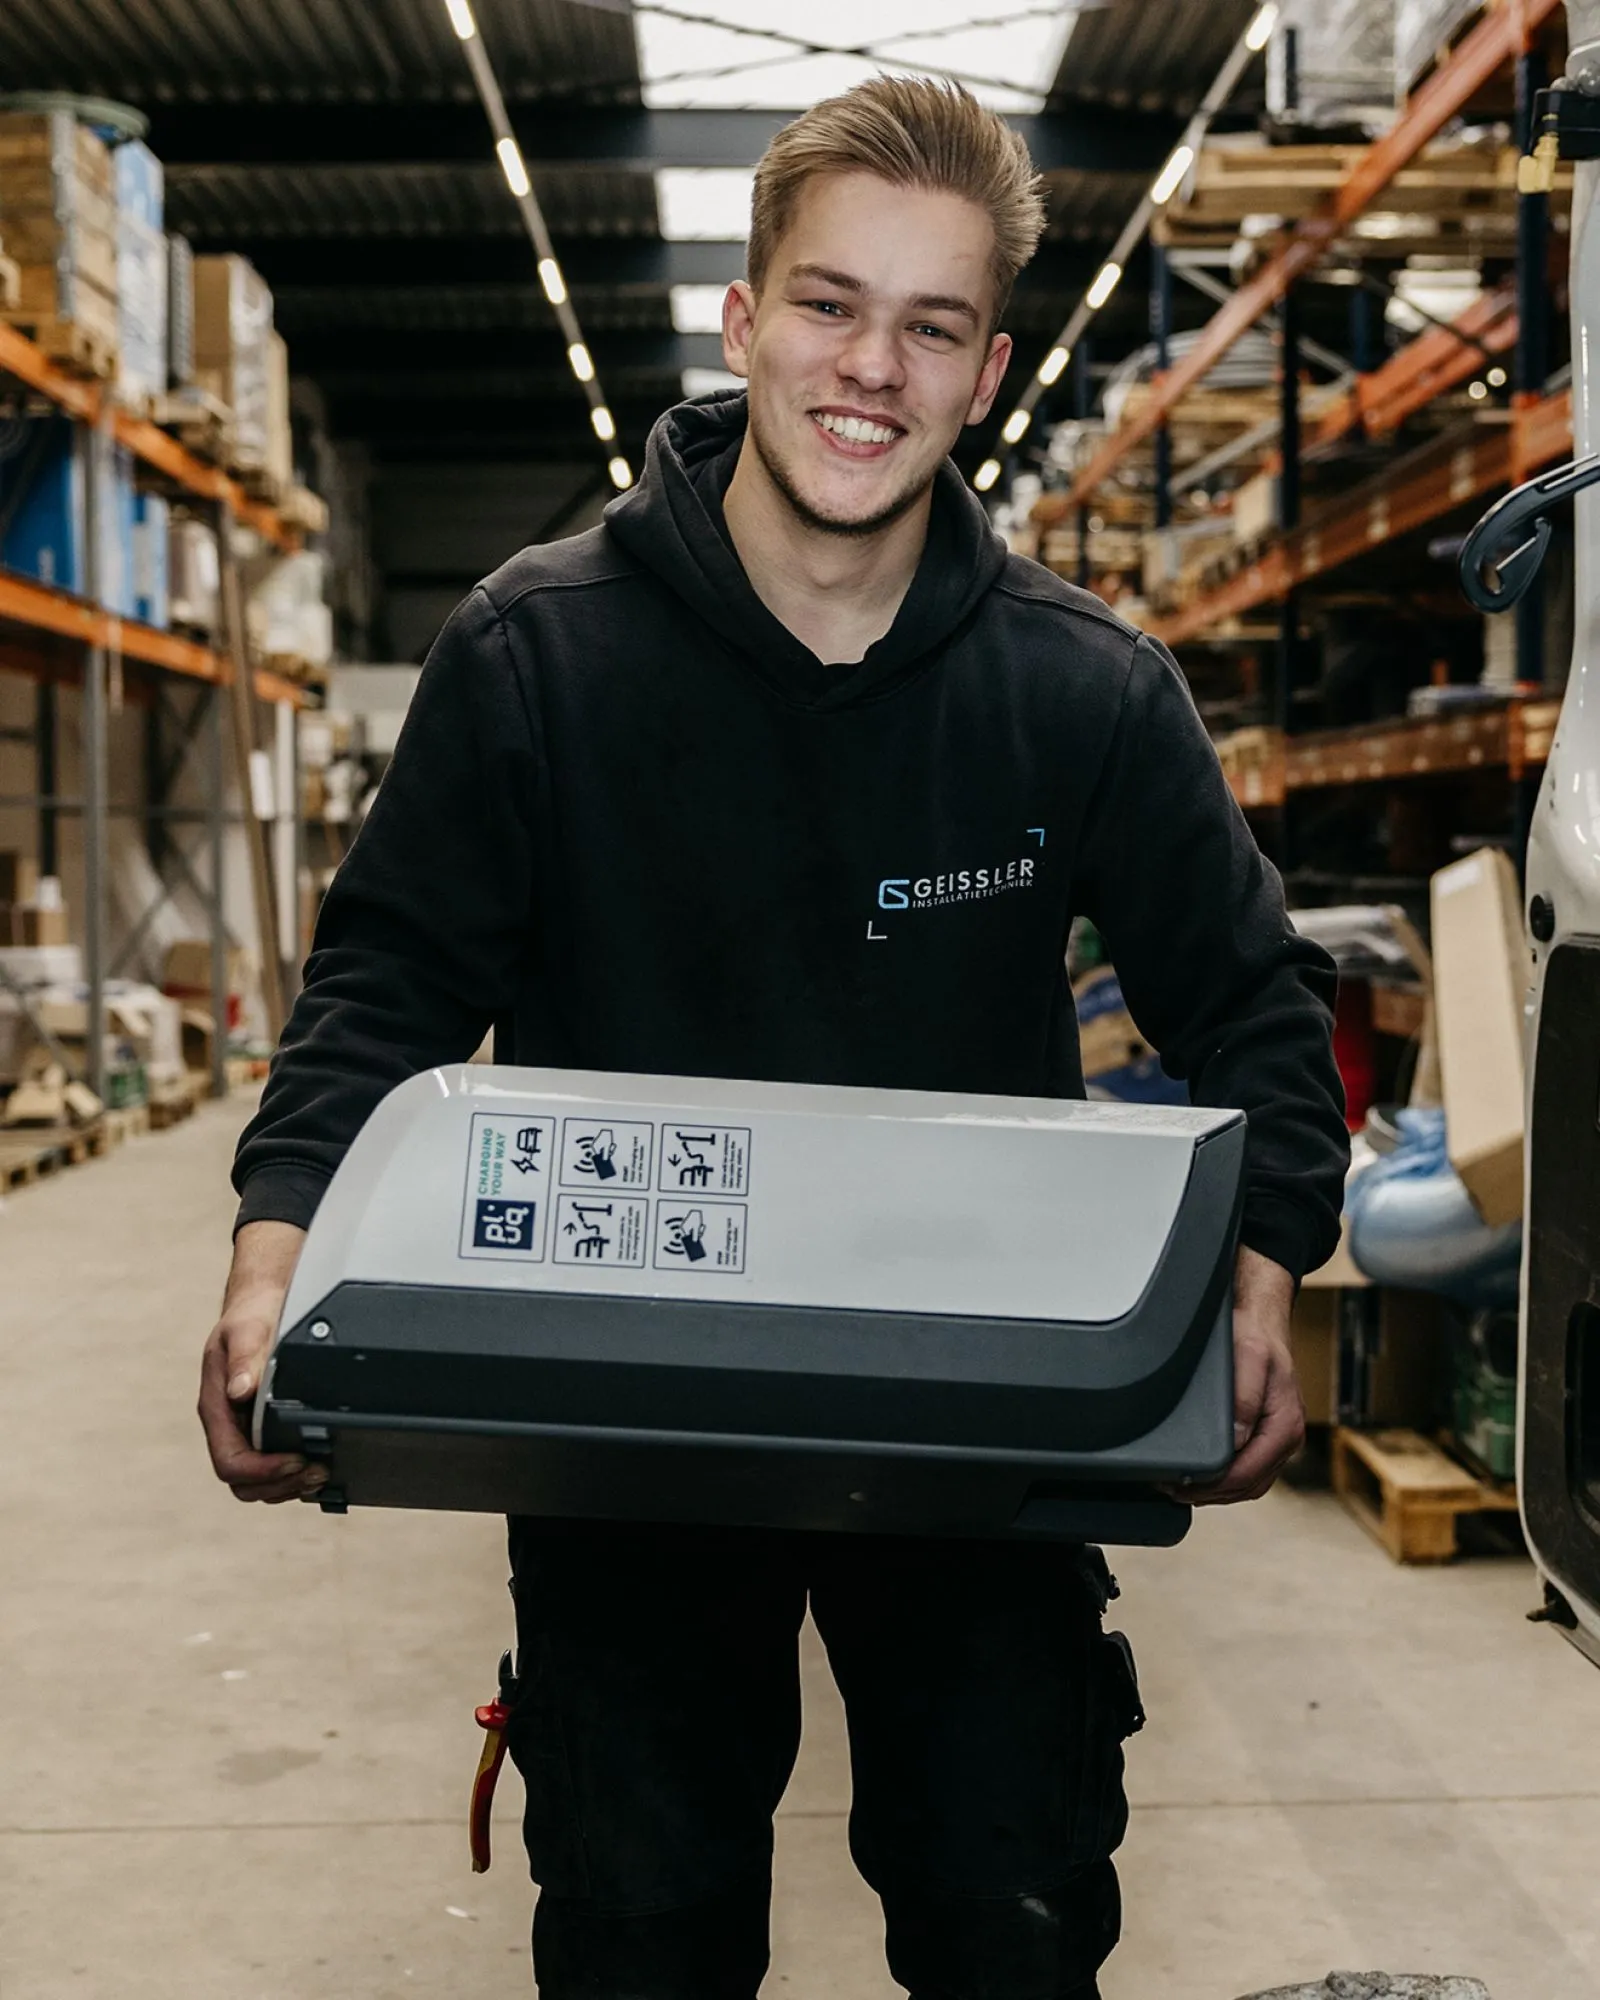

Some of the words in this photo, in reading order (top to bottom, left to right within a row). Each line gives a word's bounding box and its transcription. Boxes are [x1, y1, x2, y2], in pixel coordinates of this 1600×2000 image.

[912, 878, 1034, 909] INSTALLATIETECHNIEK
[913, 858, 1035, 898] GEISSLER
[477, 1127, 493, 1195] CHARGING
[495, 1132, 507, 1160] WAY
[490, 1162, 504, 1195] YOUR
